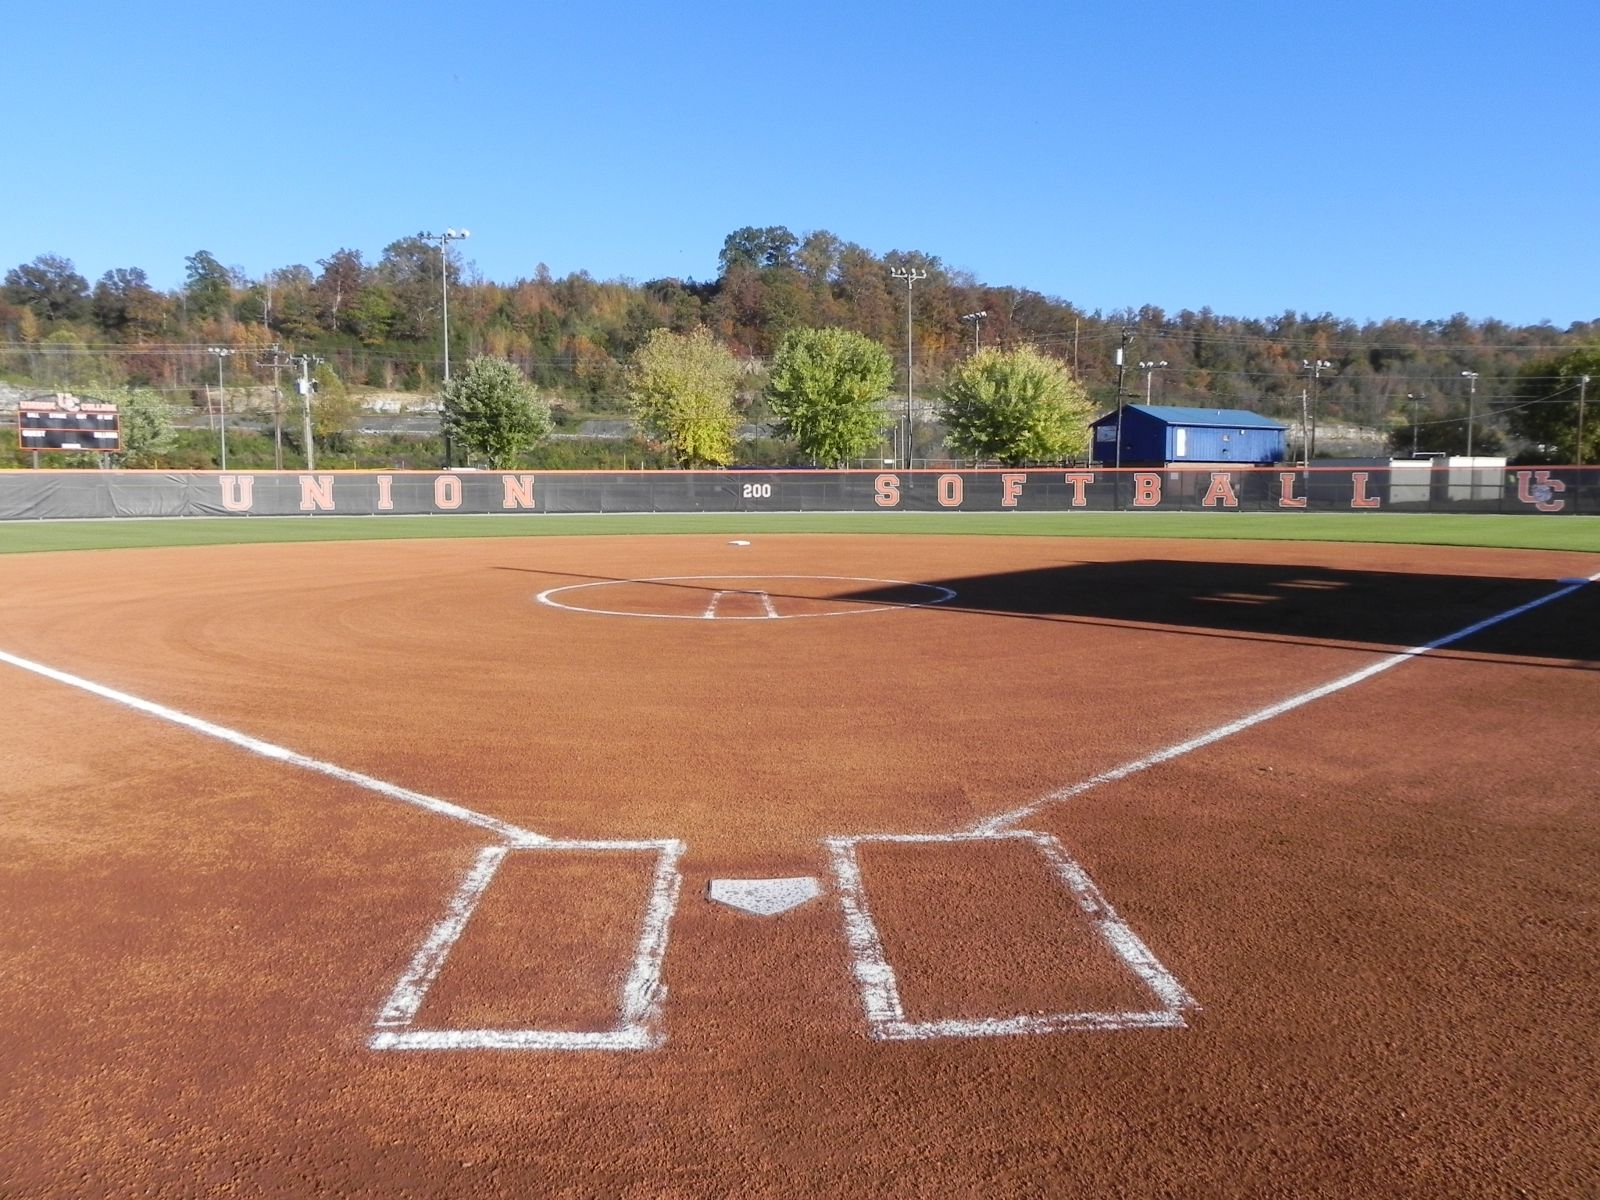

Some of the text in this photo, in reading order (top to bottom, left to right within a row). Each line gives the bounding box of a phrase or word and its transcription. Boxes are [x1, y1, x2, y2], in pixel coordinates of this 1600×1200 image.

[219, 475, 536, 511] UNION
[743, 483, 771, 498] 200
[874, 473, 1380, 508] SOFTBALL
[1517, 471, 1565, 511] UC
